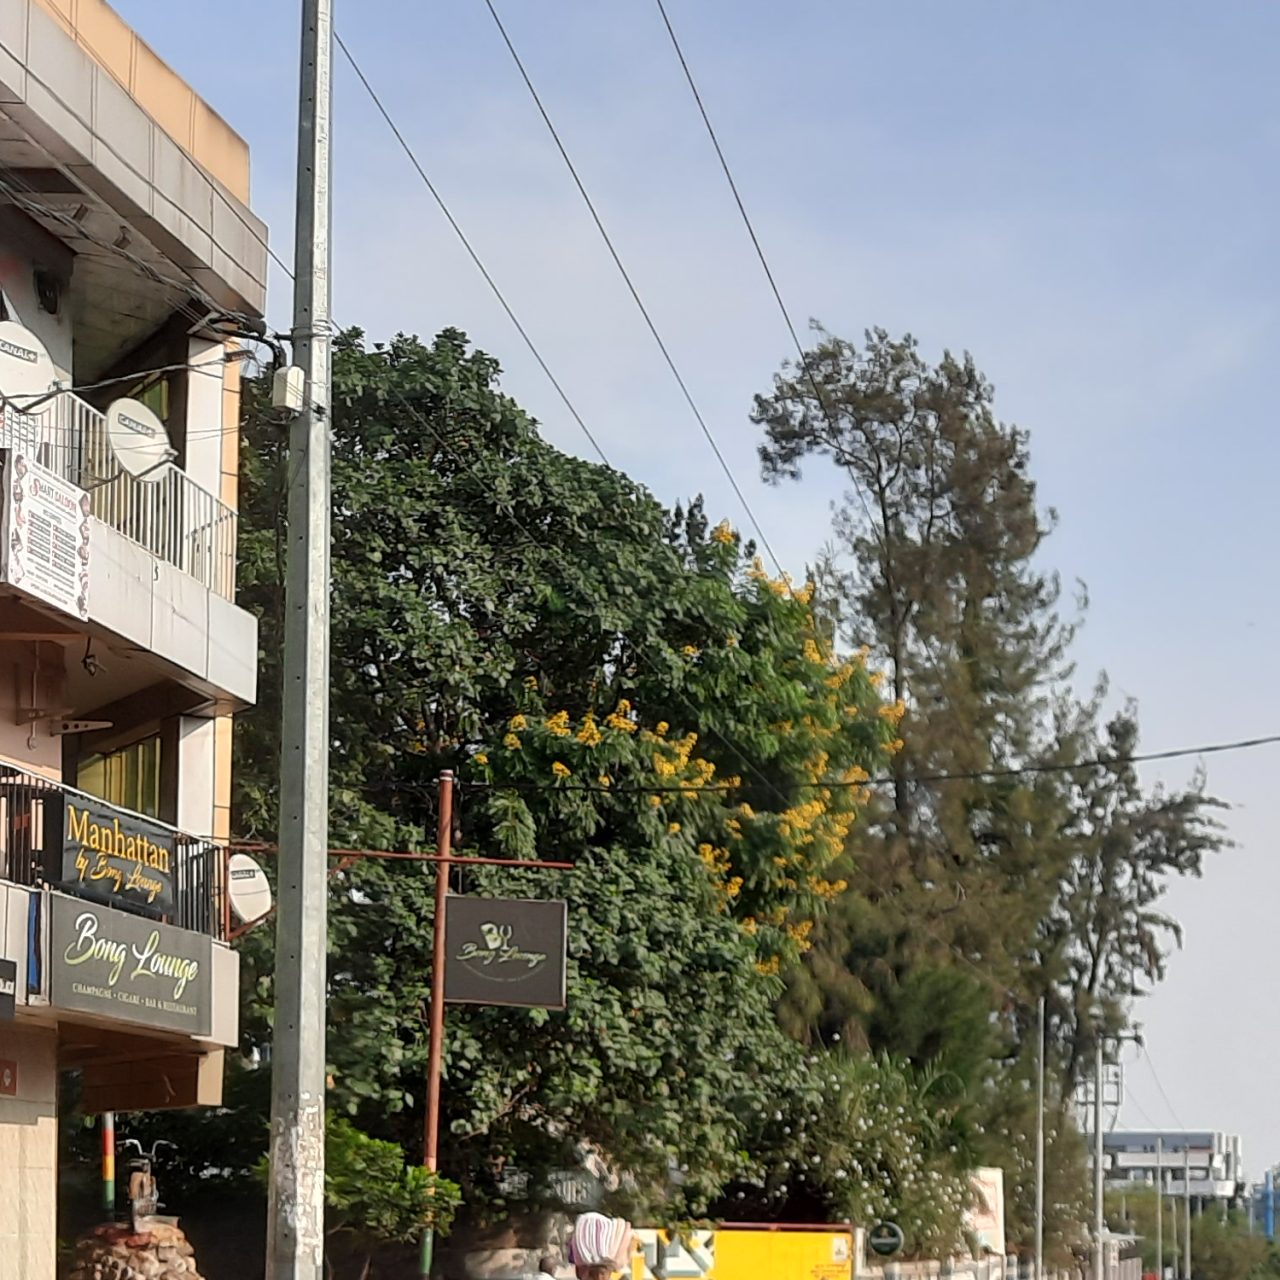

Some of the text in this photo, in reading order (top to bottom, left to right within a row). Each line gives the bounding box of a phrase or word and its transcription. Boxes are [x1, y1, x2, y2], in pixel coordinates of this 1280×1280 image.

[67, 804, 170, 874] Manhattan
[75, 847, 162, 905] by Bong Lounge
[64, 912, 199, 1000] Bong Lounge
[72, 983, 112, 999] CHAMPAGNE
